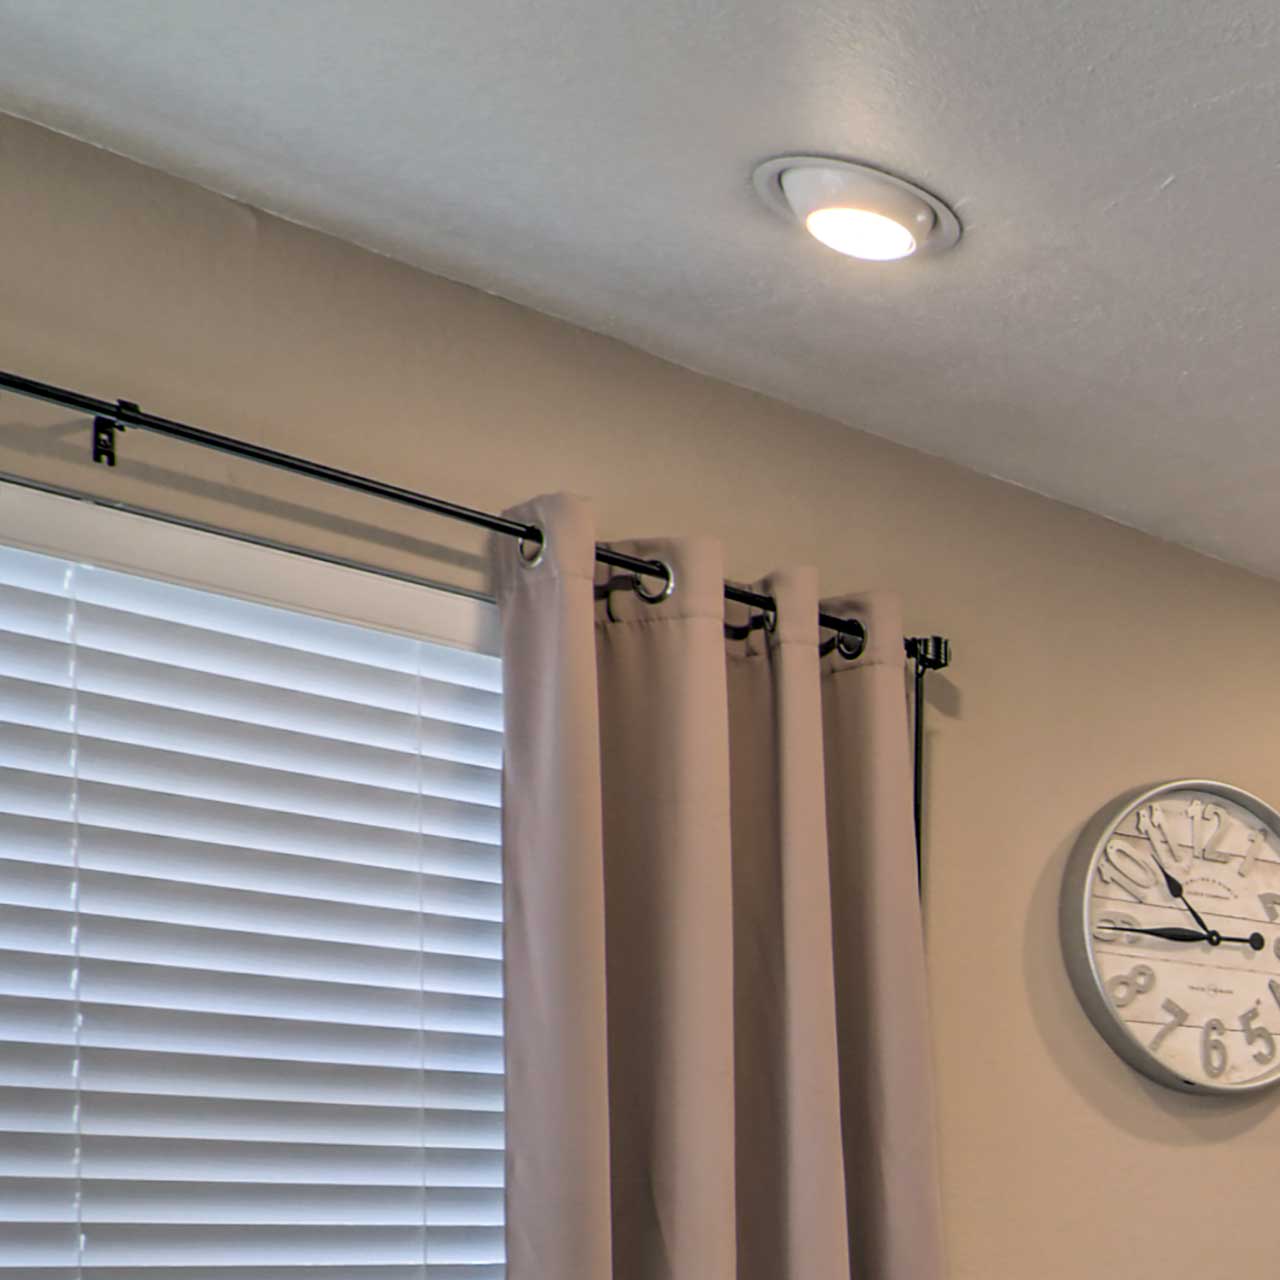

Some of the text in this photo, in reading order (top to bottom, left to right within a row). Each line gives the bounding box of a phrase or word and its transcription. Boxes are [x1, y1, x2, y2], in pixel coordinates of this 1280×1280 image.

[1136, 803, 1191, 876] 11
[1187, 799, 1229, 864] 12
[1237, 828, 1267, 878] 1
[1097, 839, 1158, 904] 10
[1093, 911, 1141, 944] 9
[1104, 965, 1156, 1008] 8
[1151, 998, 1190, 1051] 7
[1202, 1018, 1228, 1078] 6
[1238, 999, 1276, 1064] 5
